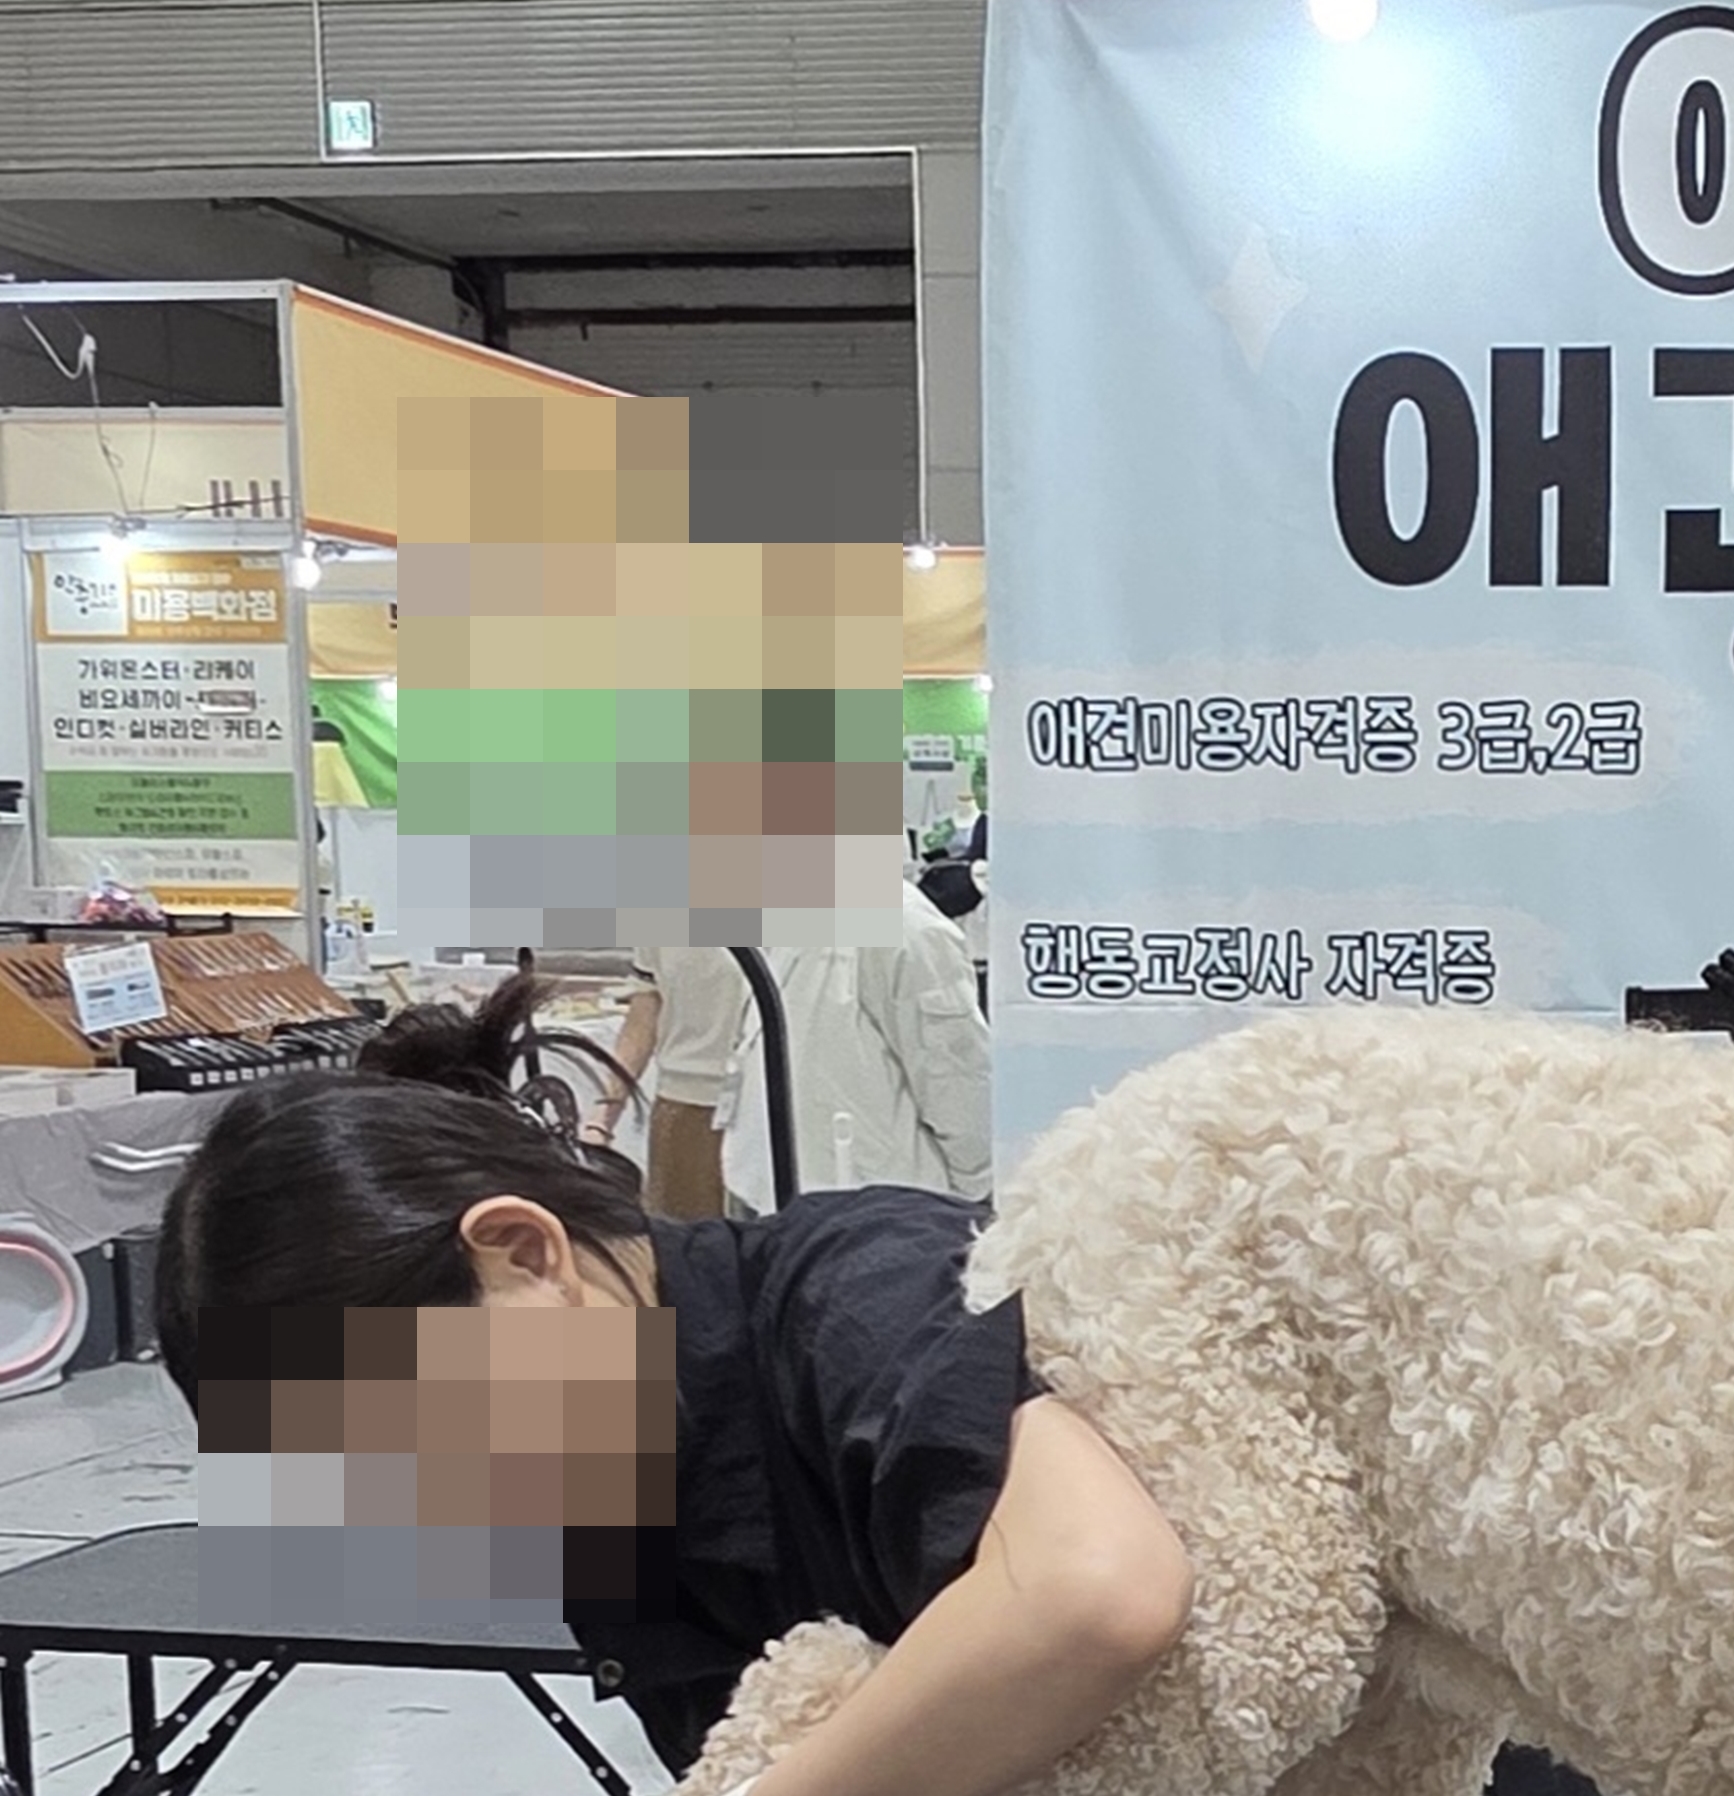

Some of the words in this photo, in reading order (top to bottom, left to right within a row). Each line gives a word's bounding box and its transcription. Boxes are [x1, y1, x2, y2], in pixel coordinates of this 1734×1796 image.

[1027, 697, 1418, 773] 애견미용자격증
[1436, 701, 1642, 775] 3급,2급
[1020, 924, 1313, 1001] 행동교정사
[1325, 930, 1496, 1003] 자격증
